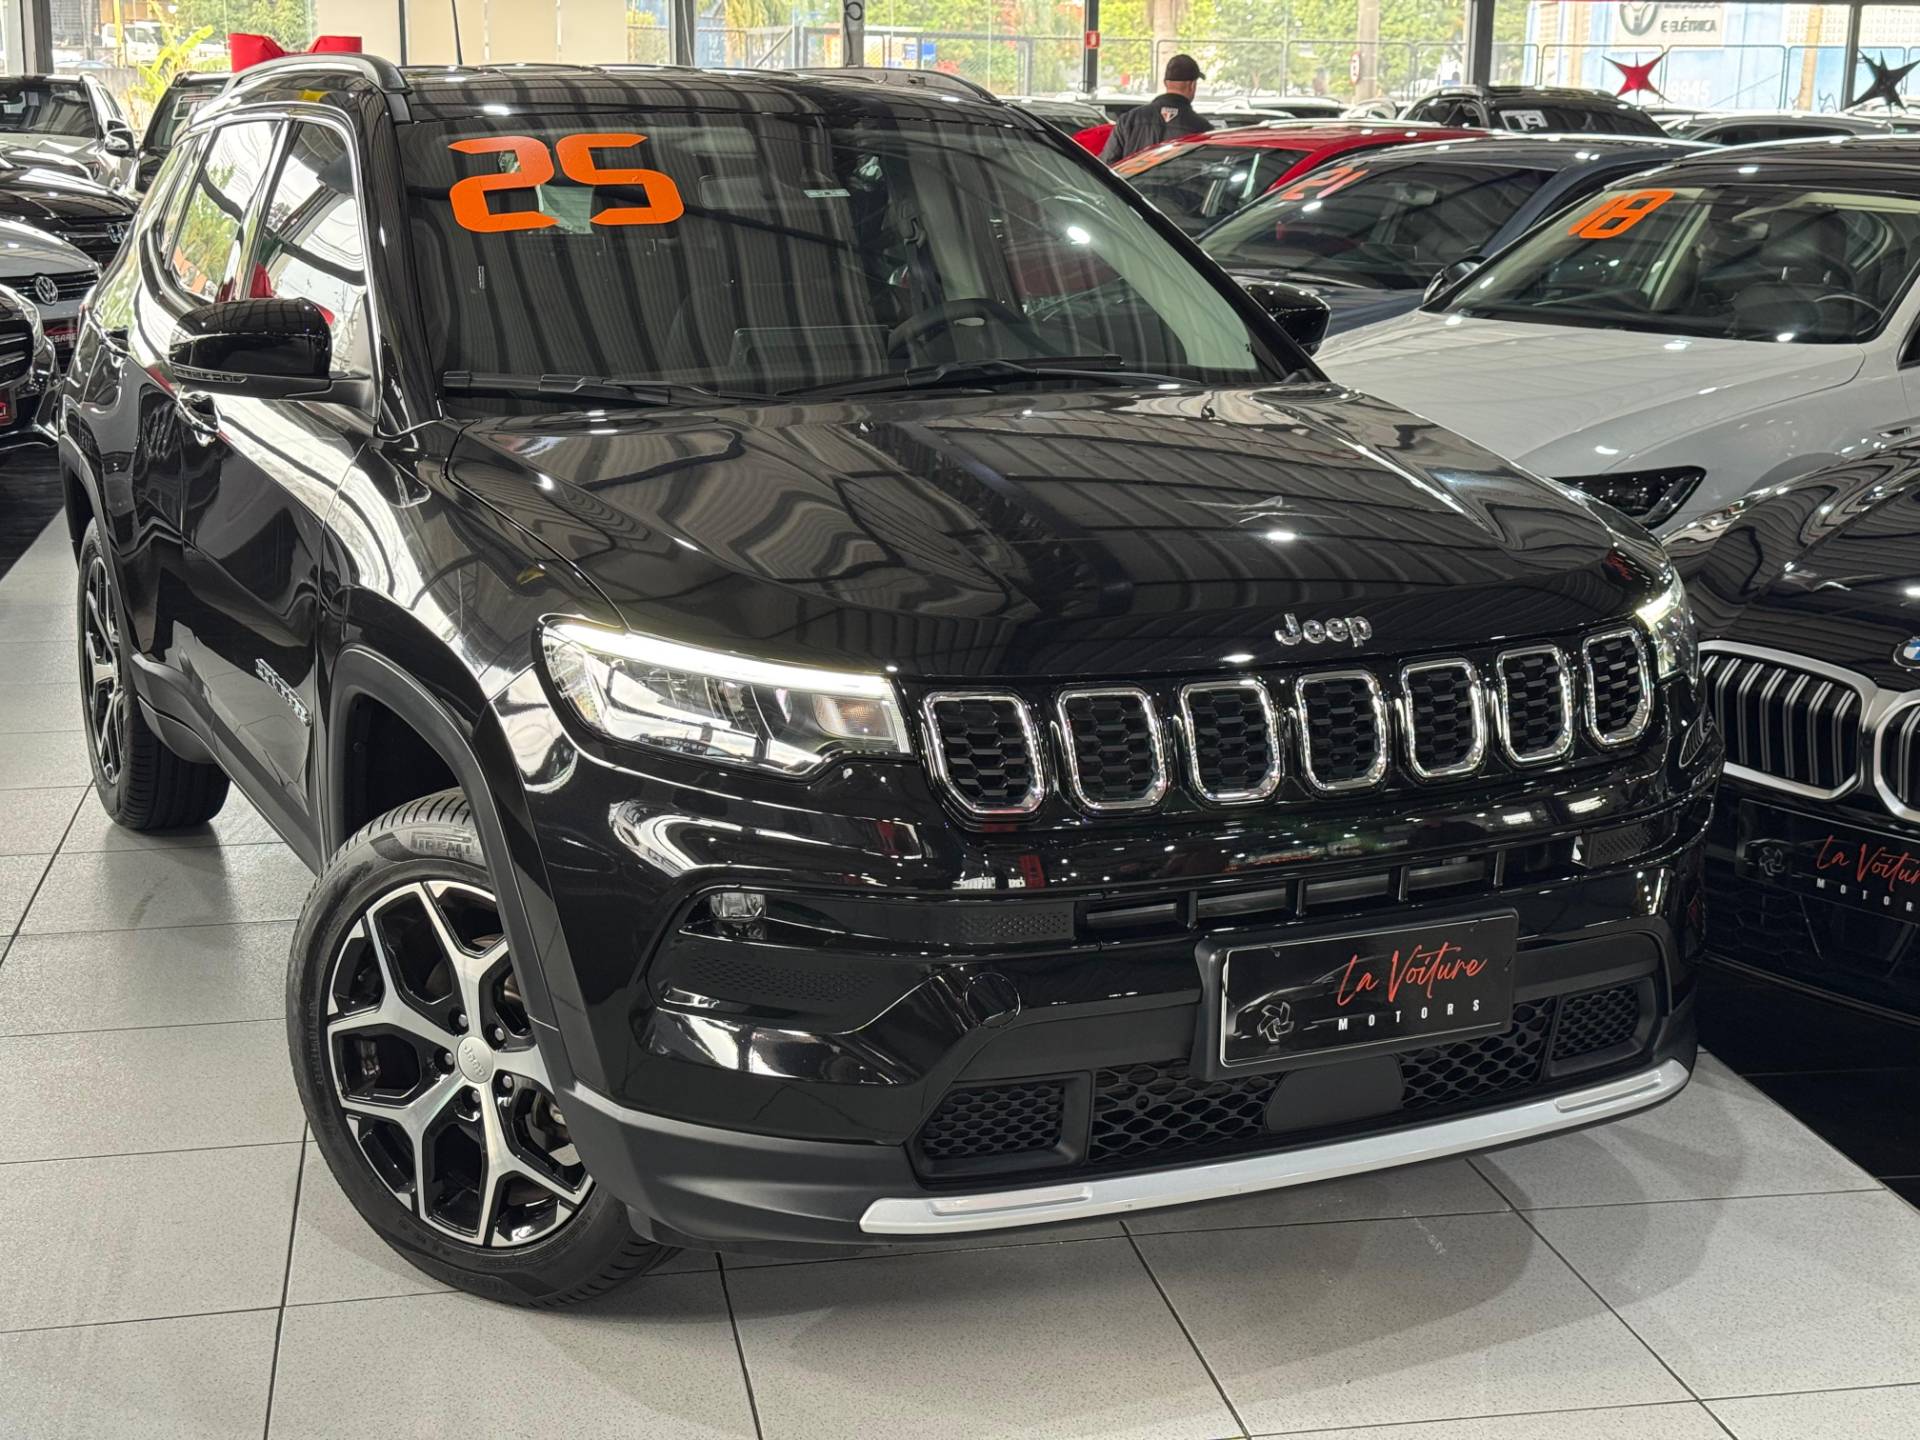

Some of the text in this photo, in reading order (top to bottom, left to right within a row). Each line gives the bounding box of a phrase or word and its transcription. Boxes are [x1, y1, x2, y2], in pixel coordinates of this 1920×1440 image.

[448, 132, 685, 233] 25
[1280, 166, 1370, 200] 21
[1567, 188, 1676, 239] 18
[1274, 612, 1373, 648] Jeep
[1815, 834, 1850, 870] La
[1336, 941, 1488, 1007] La Voiture
[1337, 999, 1481, 1032] MOTORS
